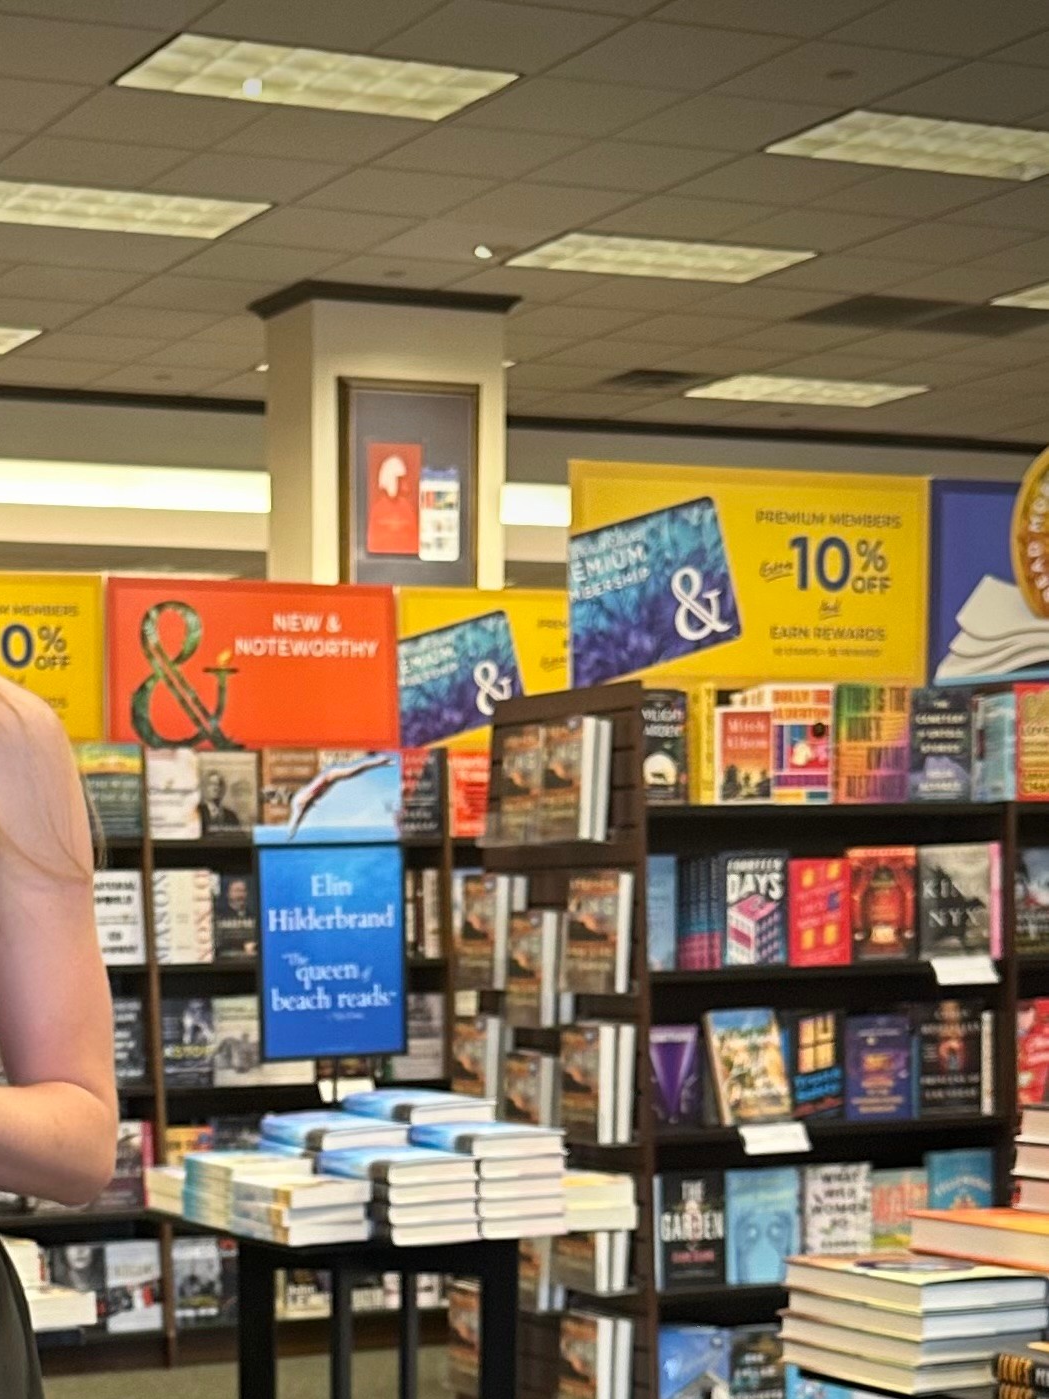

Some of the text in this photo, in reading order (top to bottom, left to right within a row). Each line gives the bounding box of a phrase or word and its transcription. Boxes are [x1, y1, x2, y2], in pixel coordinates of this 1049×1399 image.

[851, 576, 892, 594] OFF
[272, 613, 342, 632] NEW &
[234, 637, 379, 658] NOTEWORTHY
[34, 655, 71, 670] OFF
[310, 872, 353, 898] Elin
[727, 872, 784, 903] DAYS
[267, 904, 396, 933] Hilderbrand
[295, 962, 360, 991] queen
[271, 985, 333, 1012] beach
